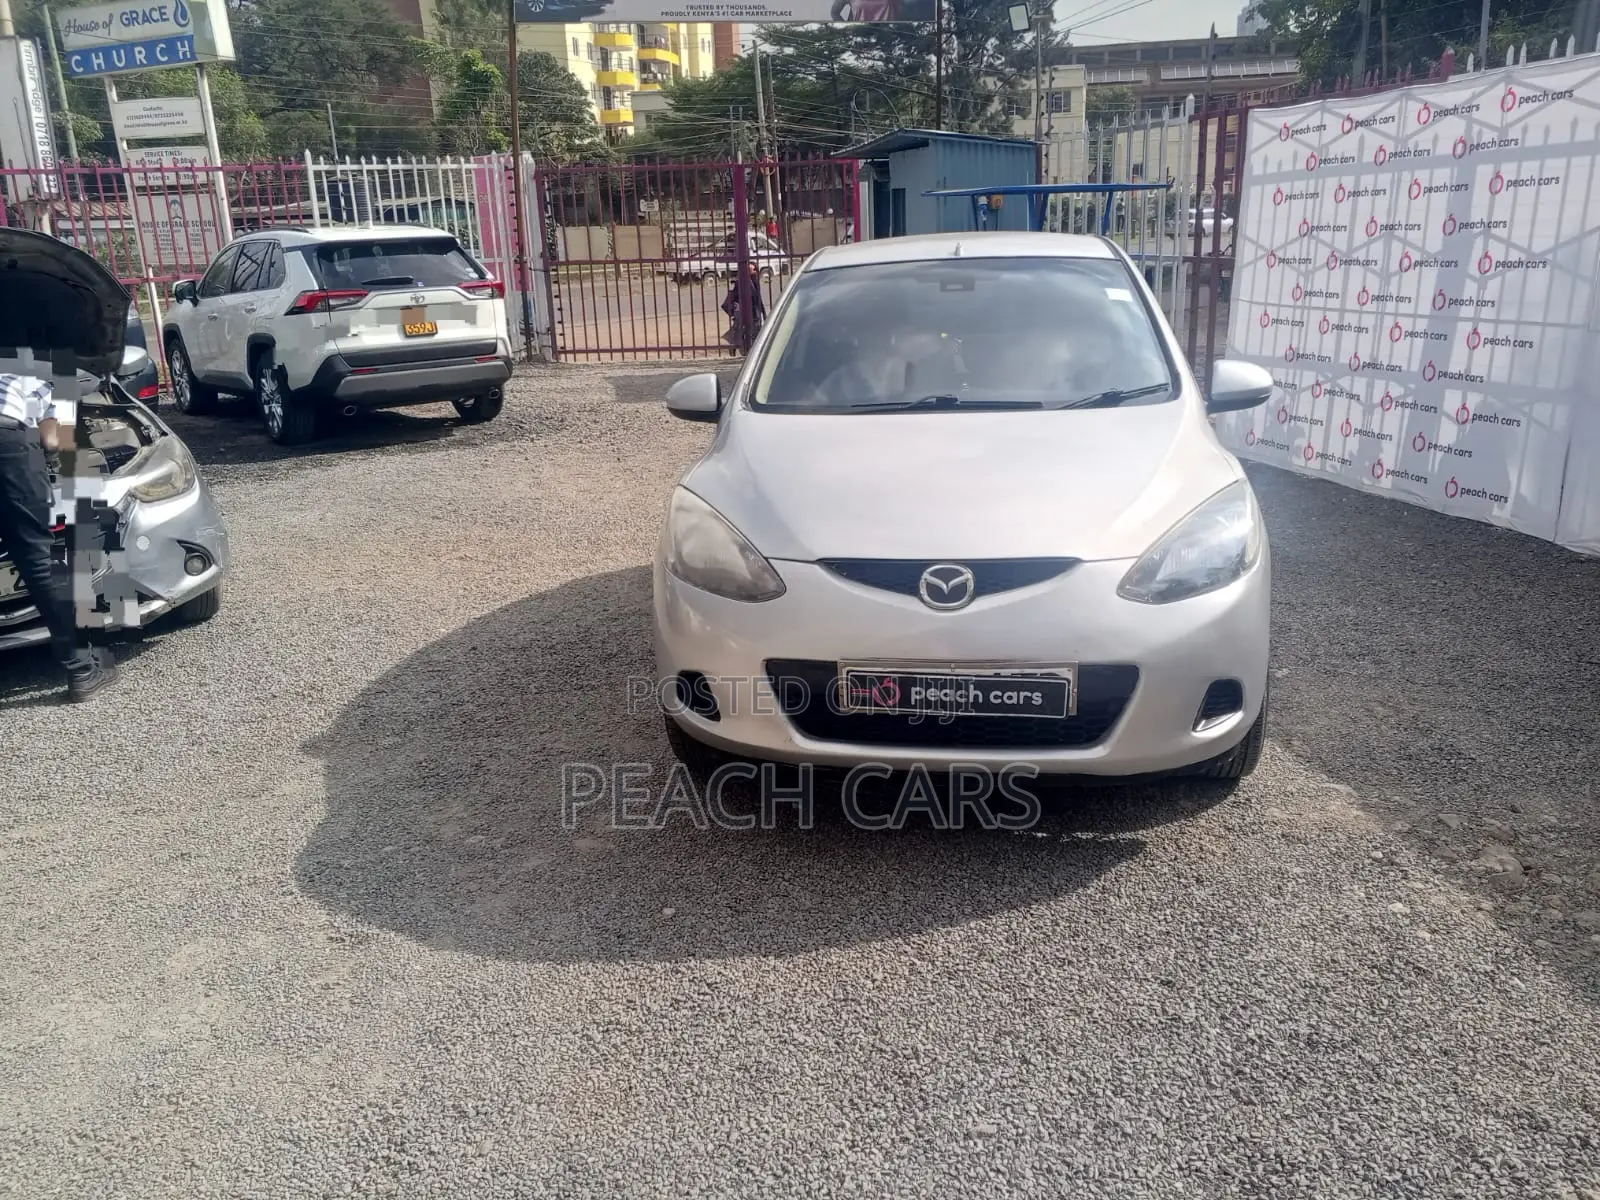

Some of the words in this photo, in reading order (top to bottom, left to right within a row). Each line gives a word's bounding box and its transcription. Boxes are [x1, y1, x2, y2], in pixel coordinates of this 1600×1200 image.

[63, 18, 99, 36] House
[102, 12, 114, 36] of
[120, 6, 169, 28] GRACE
[71, 40, 191, 72] CHURCH
[1518, 91, 1549, 107] peach
[1551, 88, 1574, 100] cars
[1433, 106, 1458, 121] peach
[1460, 103, 1480, 114] cars
[1355, 118, 1377, 130] peach
[1378, 113, 1395, 125] cars
[36, 122, 50, 146] 0718
[1291, 128, 1310, 138] peach
[1311, 123, 1327, 133] cars
[1469, 138, 1496, 154] peach
[1499, 138, 1519, 148] cars
[1318, 157, 1339, 168] peach
[1340, 155, 1355, 163] cars
[1388, 148, 1412, 162] peach
[1413, 148, 1431, 157] cars
[1423, 182, 1448, 196] peach
[1450, 183, 1469, 192] cars
[1506, 175, 1535, 190] peach
[1538, 176, 1560, 185] cars
[1284, 190, 1304, 202] peach
[1304, 191, 1319, 200] cars
[1347, 188, 1368, 200] peach
[1370, 188, 1386, 196] cars
[1310, 224, 1331, 235] peach
[1333, 224, 1347, 232] cars
[1380, 221, 1403, 233] peach
[1404, 222, 1421, 231] cars
[1458, 219, 1486, 233] peach
[1488, 219, 1507, 229] cars
[1278, 256, 1296, 267] peach
[1339, 256, 1360, 268] peach
[1414, 258, 1438, 270] peach
[1440, 260, 1458, 268] cars
[1495, 257, 1523, 271] peach
[1526, 260, 1547, 268] cars
[1304, 289, 1323, 299] peach
[1371, 292, 1393, 304] peach
[1448, 296, 1474, 308] peach
[1271, 317, 1289, 326] peach
[1331, 322, 1352, 333] peach
[1404, 330, 1428, 340] peach
[1430, 333, 1448, 341] cars
[1483, 336, 1511, 348] peach
[1513, 340, 1534, 348] cars
[1296, 352, 1316, 361] peach
[1362, 361, 1384, 370] peach
[1386, 364, 1402, 372] cars
[1438, 367, 1463, 380] peach
[1465, 373, 1484, 383] cars
[1323, 388, 1344, 397] peach
[1346, 392, 1360, 400] cars
[1394, 400, 1418, 410] peach
[1420, 405, 1438, 413] cars
[1289, 414, 1308, 423] peach
[1472, 413, 1498, 424] peach
[1501, 417, 1521, 427] cars
[1353, 427, 1375, 439] peach
[1377, 432, 1392, 441] cars
[1256, 438, 1275, 447] peach
[1276, 442, 1290, 451] cars
[1428, 441, 1452, 454] peach
[1454, 448, 1472, 458] cars
[1315, 451, 1336, 462] peach
[1337, 457, 1352, 466] cars
[1385, 468, 1409, 479] peach
[1411, 474, 1428, 484] cars
[1460, 487, 1487, 498] peach
[1489, 493, 1508, 503] cars
[910, 685, 982, 705] peach
[990, 690, 1042, 706] cars
